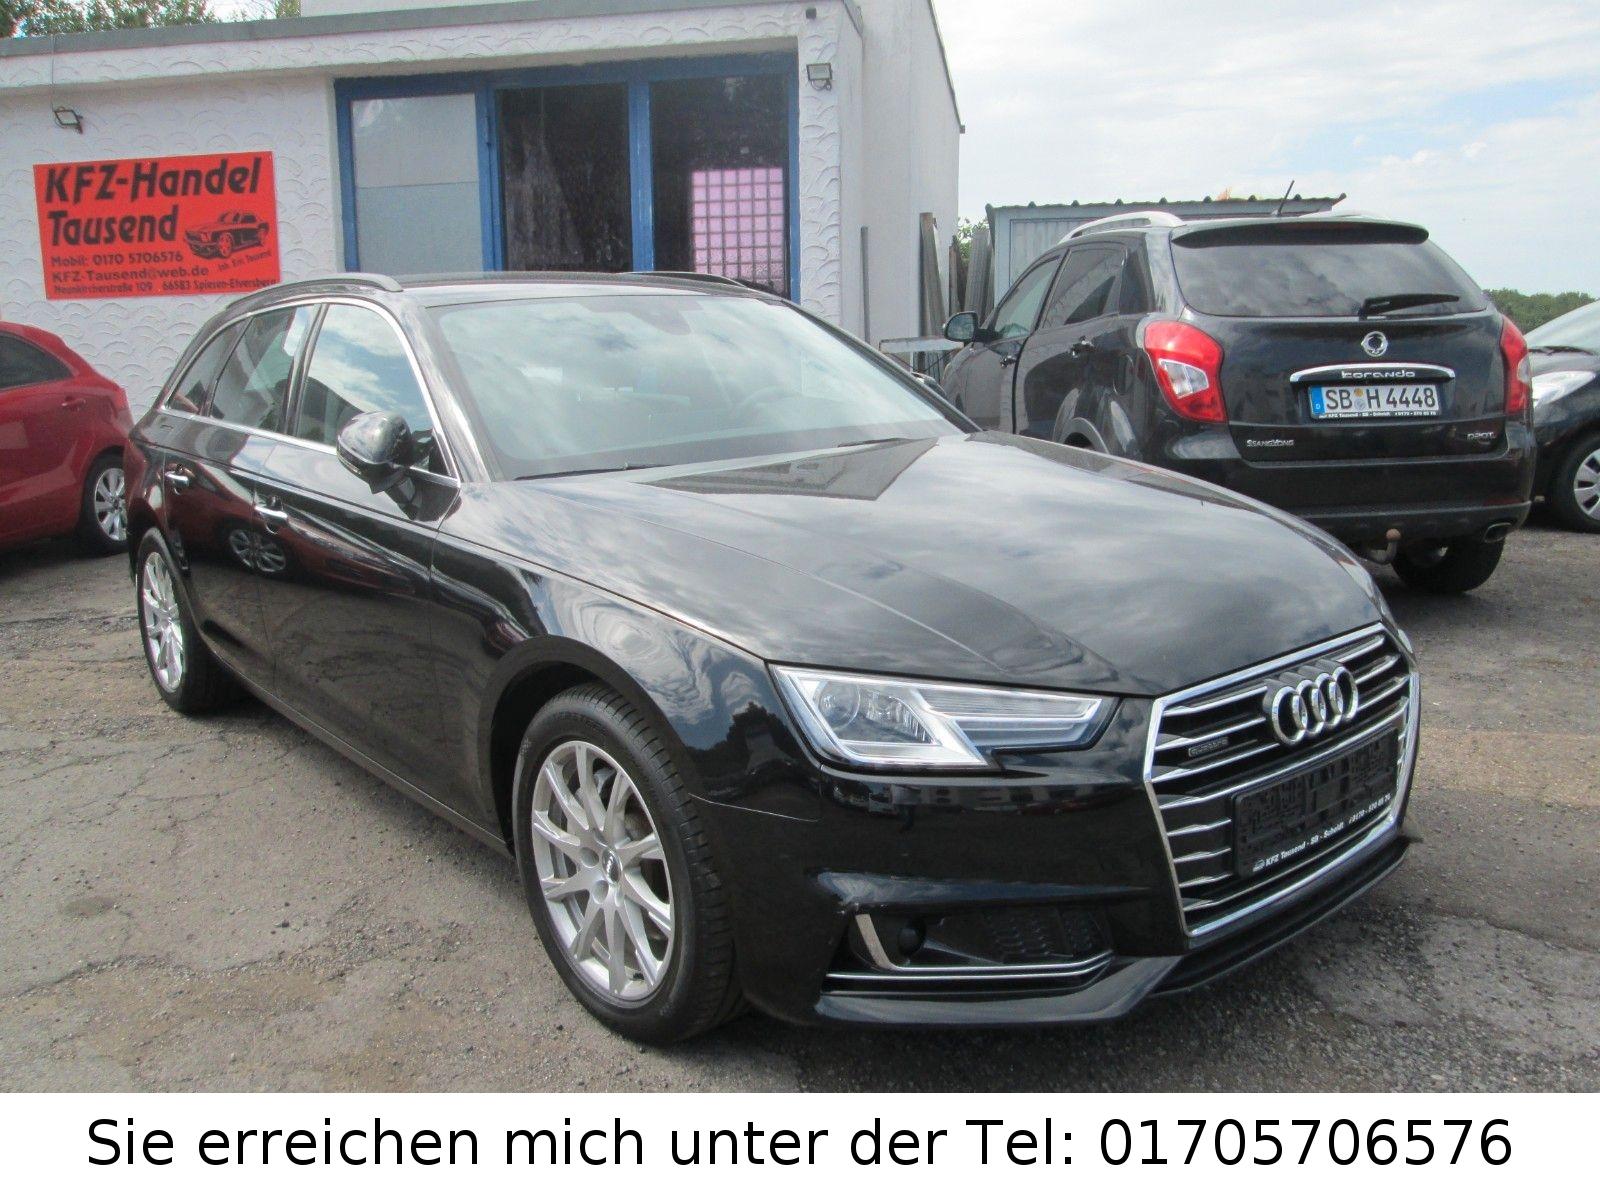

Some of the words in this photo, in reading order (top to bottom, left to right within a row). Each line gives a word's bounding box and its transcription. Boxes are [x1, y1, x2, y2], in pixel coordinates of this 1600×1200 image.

[45, 157, 262, 204] KFZ-Handel
[48, 204, 179, 247] Tausend
[51, 255, 88, 267] Mobil:
[92, 253, 124, 266] 0170
[128, 251, 184, 264] 5706576
[1325, 388, 1353, 411] SB
[1366, 387, 1380, 409] H
[1385, 387, 1436, 409] 4448
